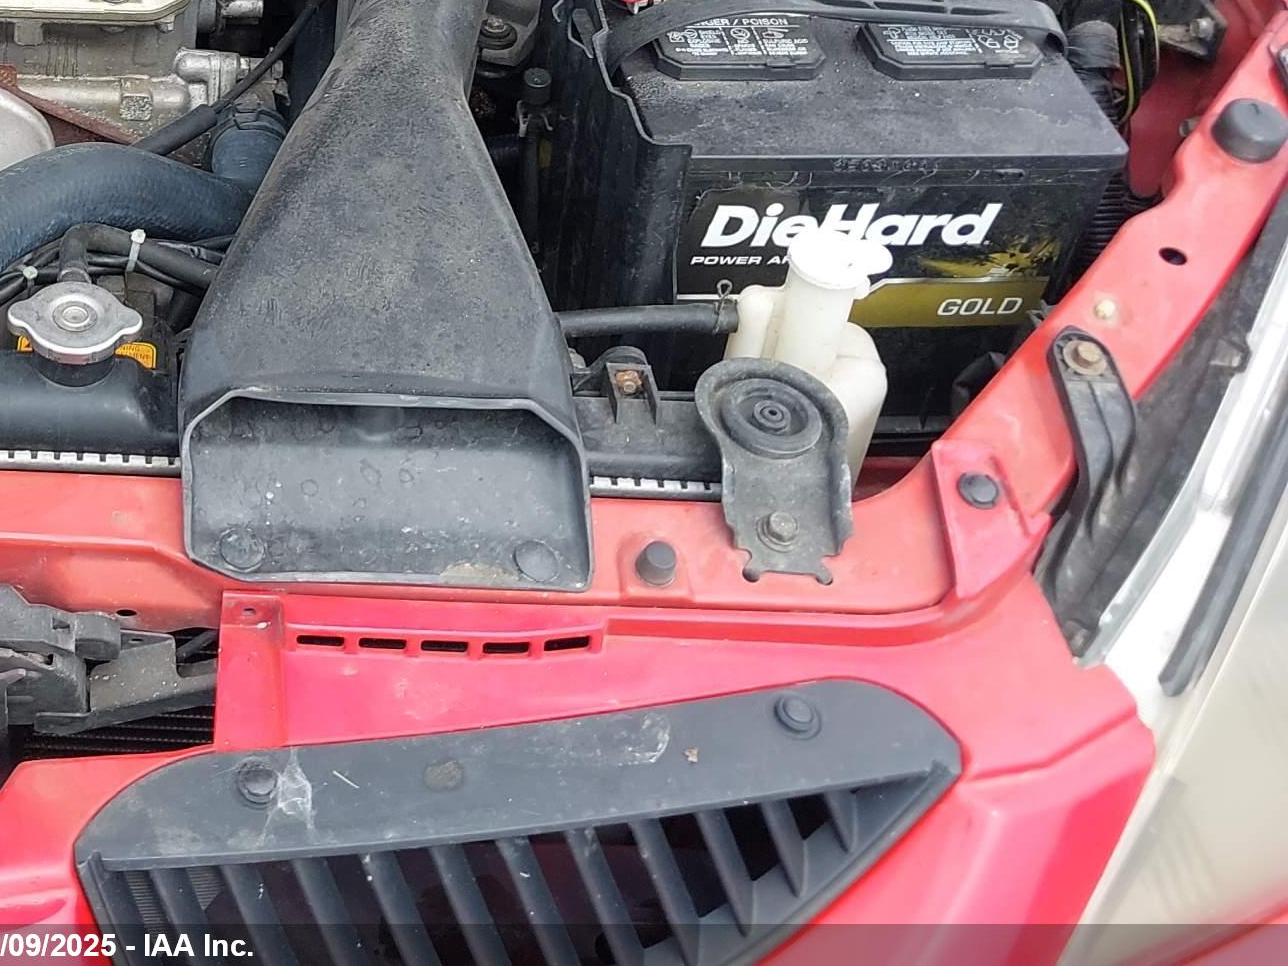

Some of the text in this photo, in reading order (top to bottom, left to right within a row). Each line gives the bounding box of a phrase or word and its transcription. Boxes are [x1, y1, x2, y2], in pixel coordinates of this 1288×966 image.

[741, 18, 789, 26] POISON
[701, 202, 1003, 248] DieHard
[690, 256, 761, 265] POWER
[937, 297, 1023, 316] GOLD
